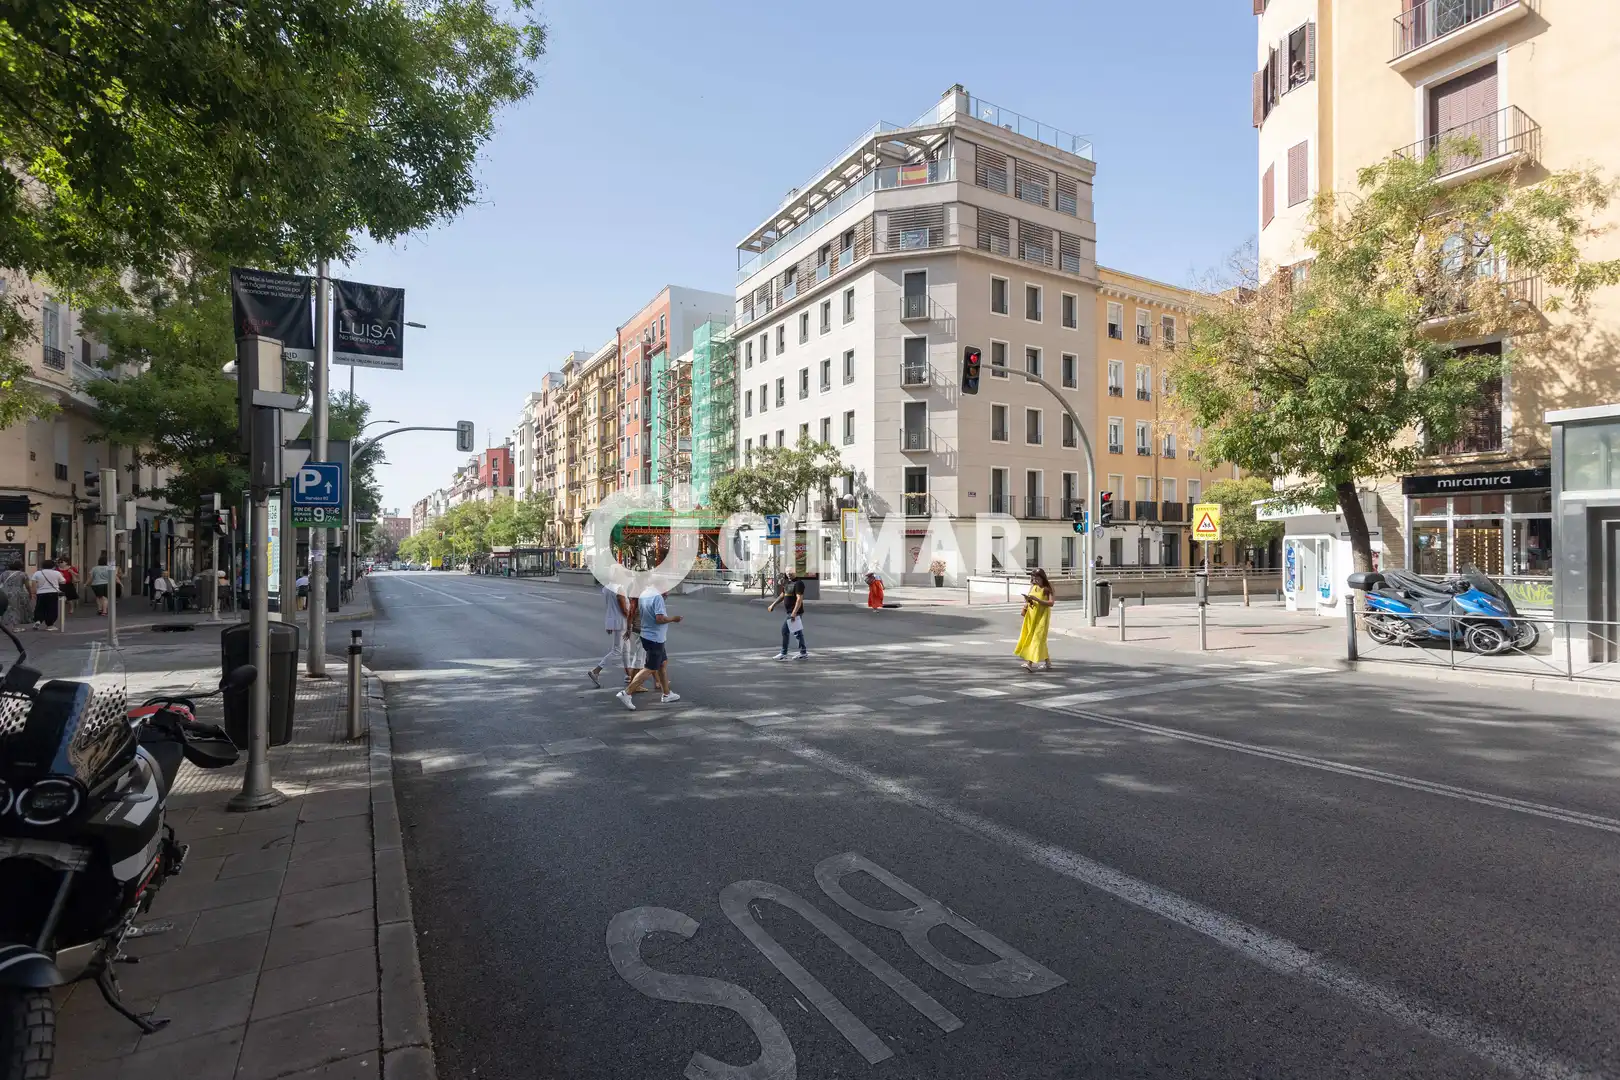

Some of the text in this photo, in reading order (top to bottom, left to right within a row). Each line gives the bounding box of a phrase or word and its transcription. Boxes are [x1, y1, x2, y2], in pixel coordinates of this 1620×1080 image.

[339, 320, 396, 340] LUISA
[349, 335, 366, 343] tiene
[298, 468, 322, 494] P
[1437, 475, 1512, 488] miramira
[313, 507, 325, 522] 9
[606, 851, 1068, 1080] BUS
